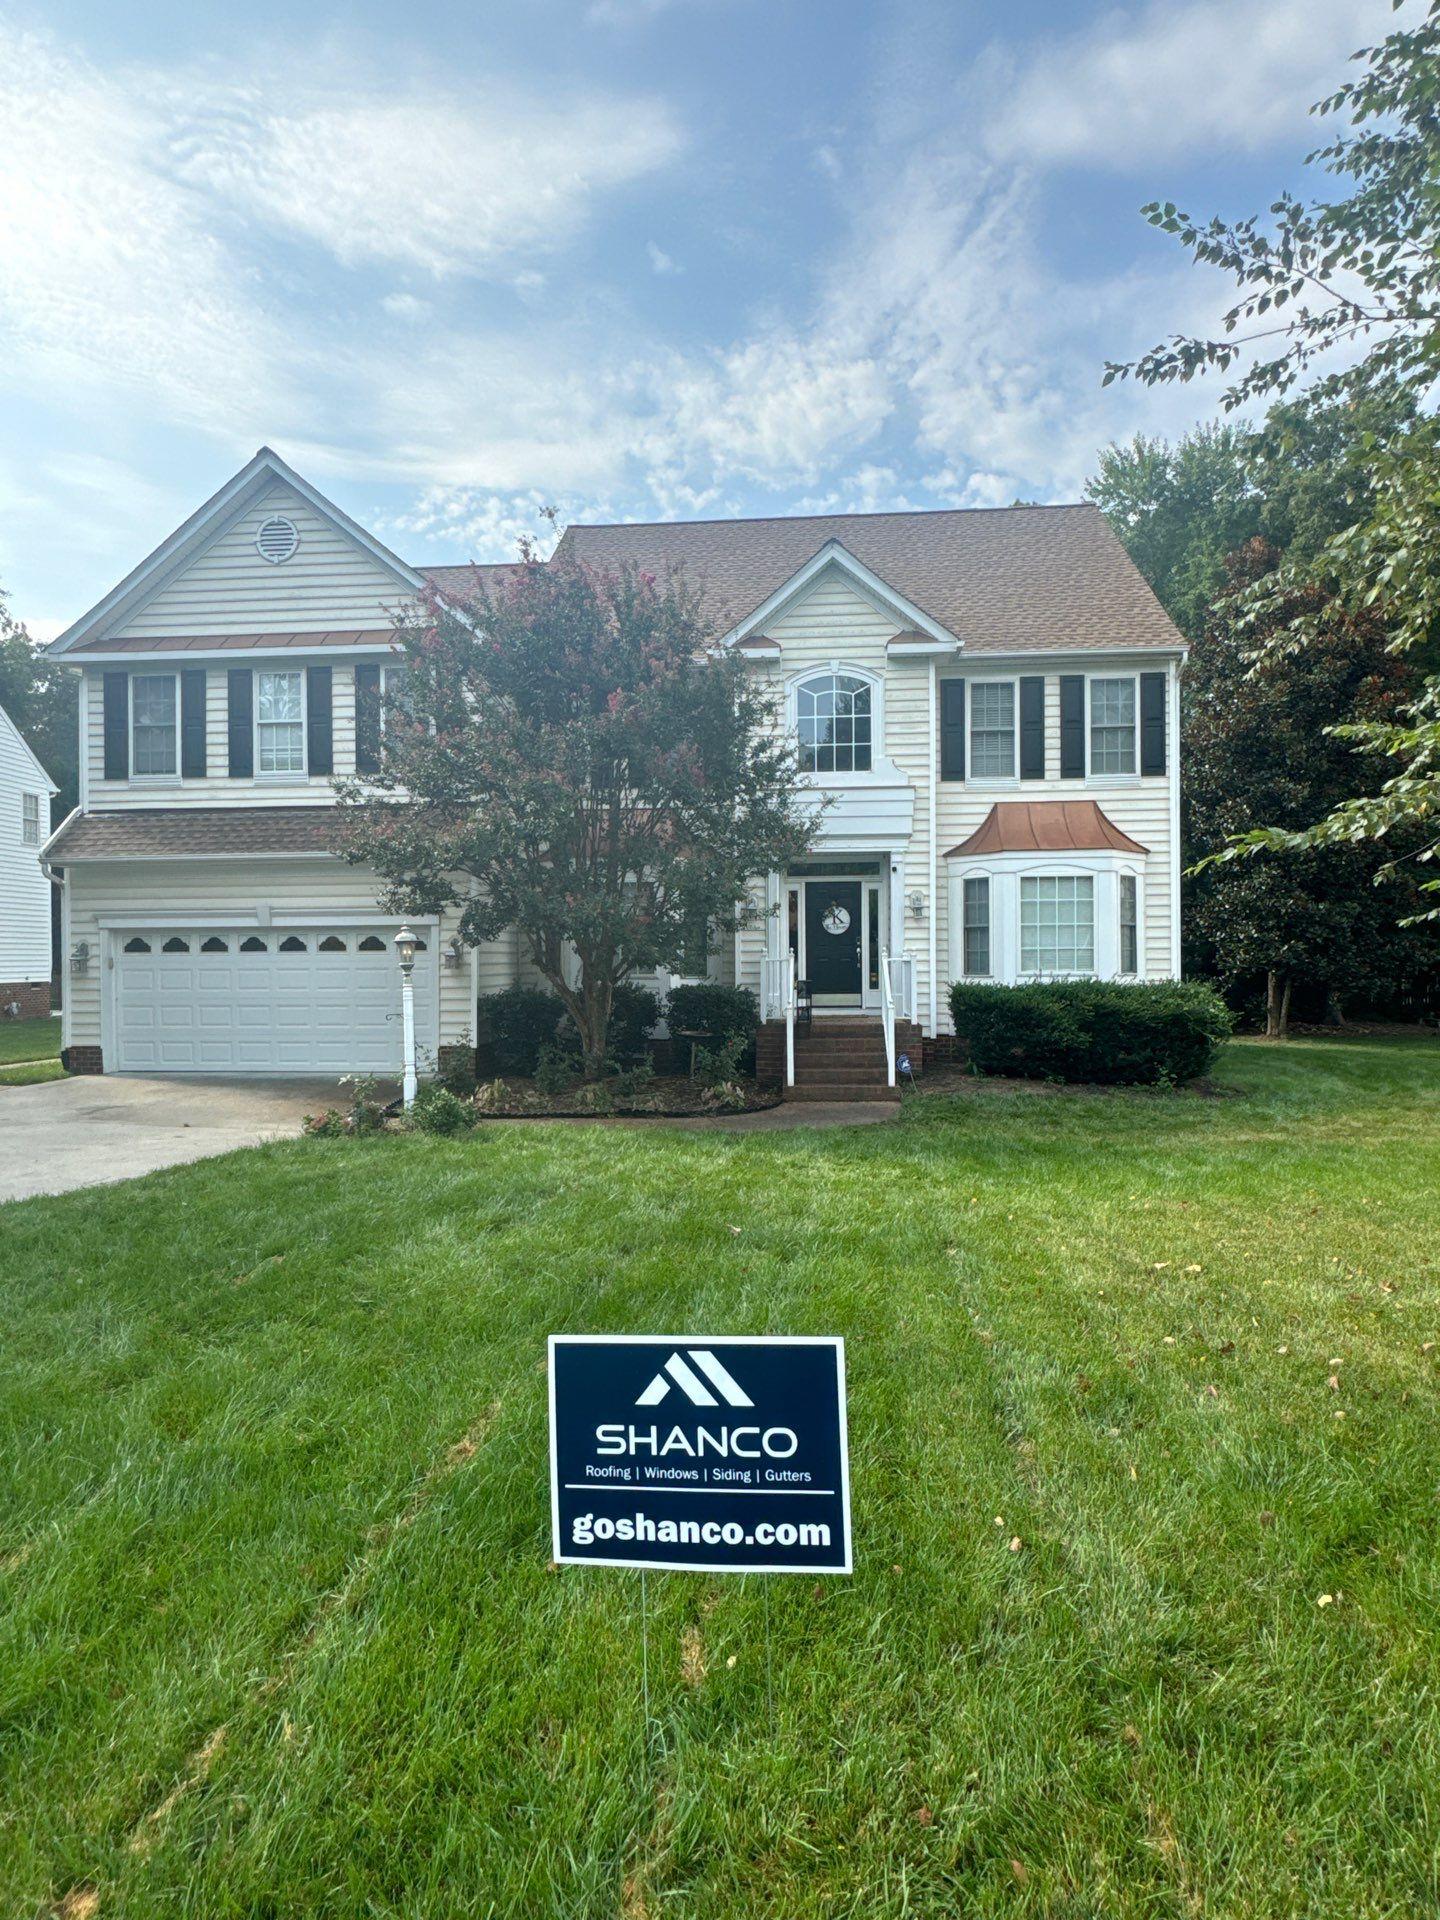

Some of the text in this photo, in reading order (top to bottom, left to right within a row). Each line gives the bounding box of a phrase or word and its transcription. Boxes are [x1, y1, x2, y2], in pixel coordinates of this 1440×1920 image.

[595, 1424, 798, 1458] SHANCO
[585, 1465, 631, 1481] Roofing
[644, 1466, 699, 1480] Windows
[712, 1468, 751, 1483] Siding
[765, 1469, 812, 1482] Gutters
[572, 1512, 831, 1546] goshanco.com
